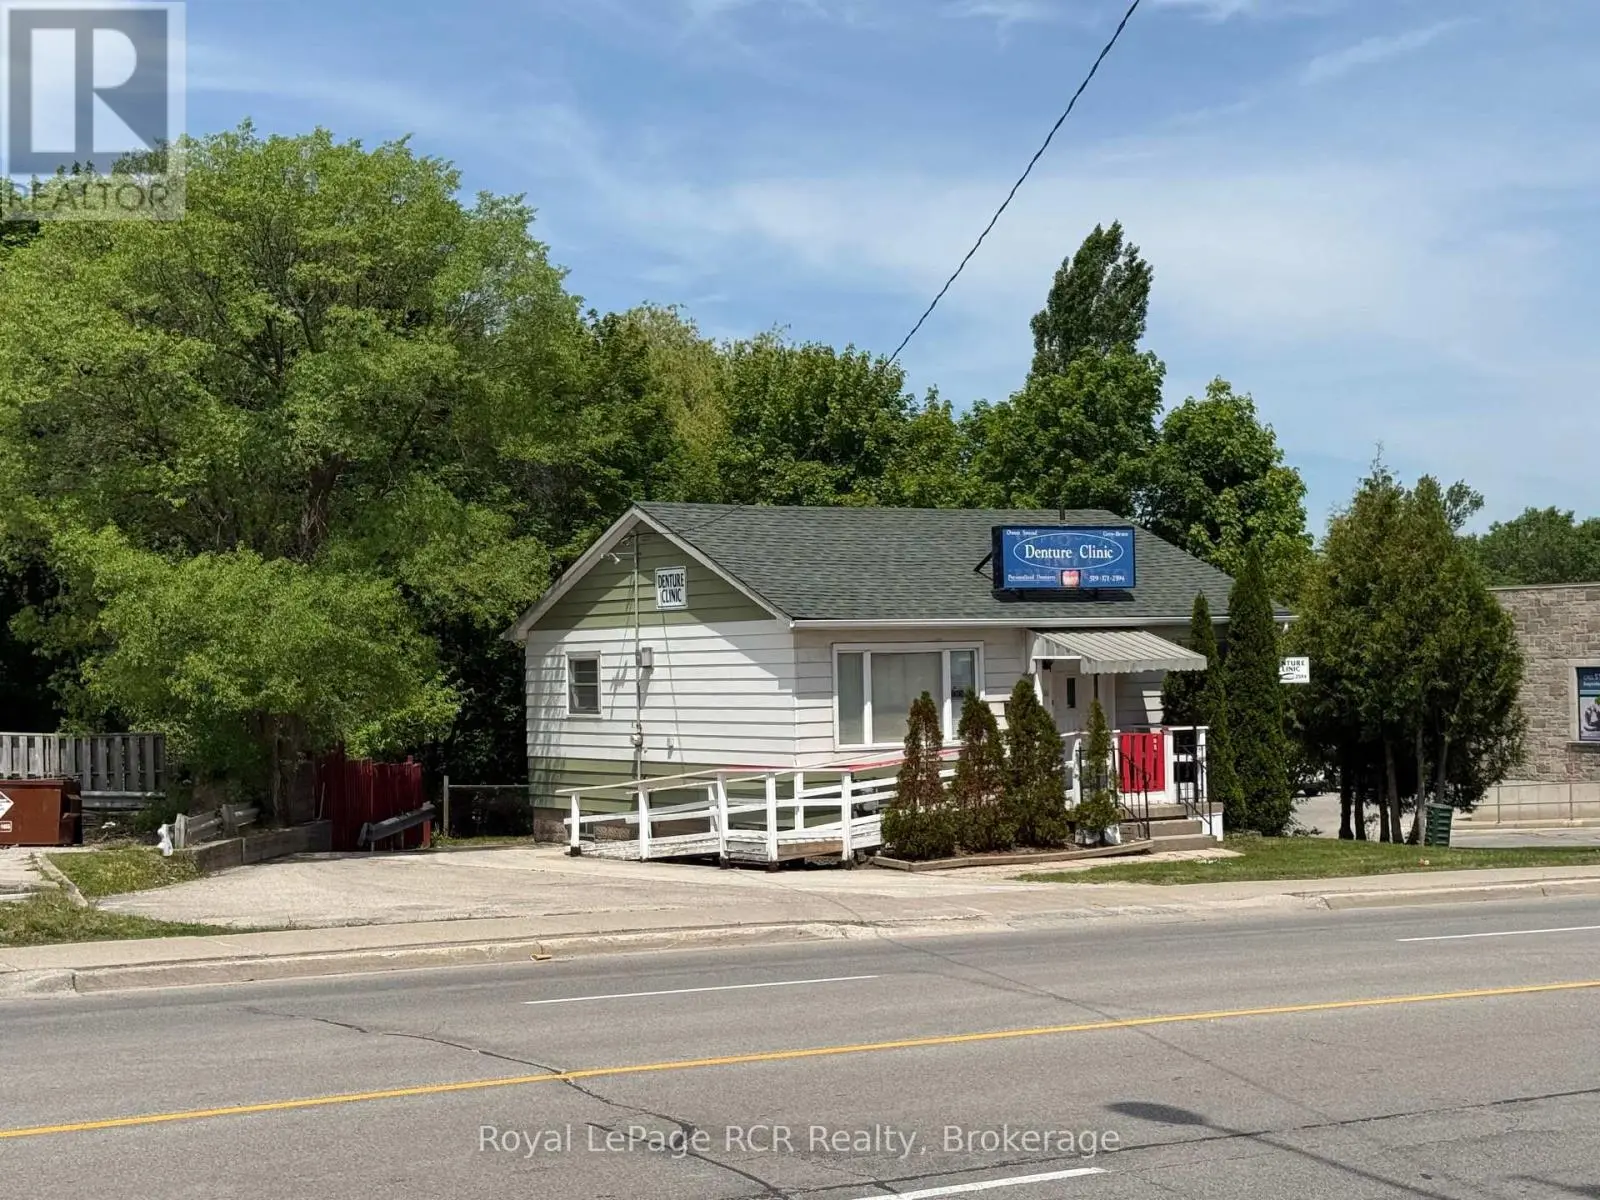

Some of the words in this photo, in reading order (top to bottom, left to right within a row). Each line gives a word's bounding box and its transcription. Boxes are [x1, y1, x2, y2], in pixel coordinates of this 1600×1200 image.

[1025, 544, 1073, 559] Denture
[1079, 544, 1114, 559] Clinic
[658, 573, 684, 588] DENTURE
[662, 588, 681, 603] CLINIC
